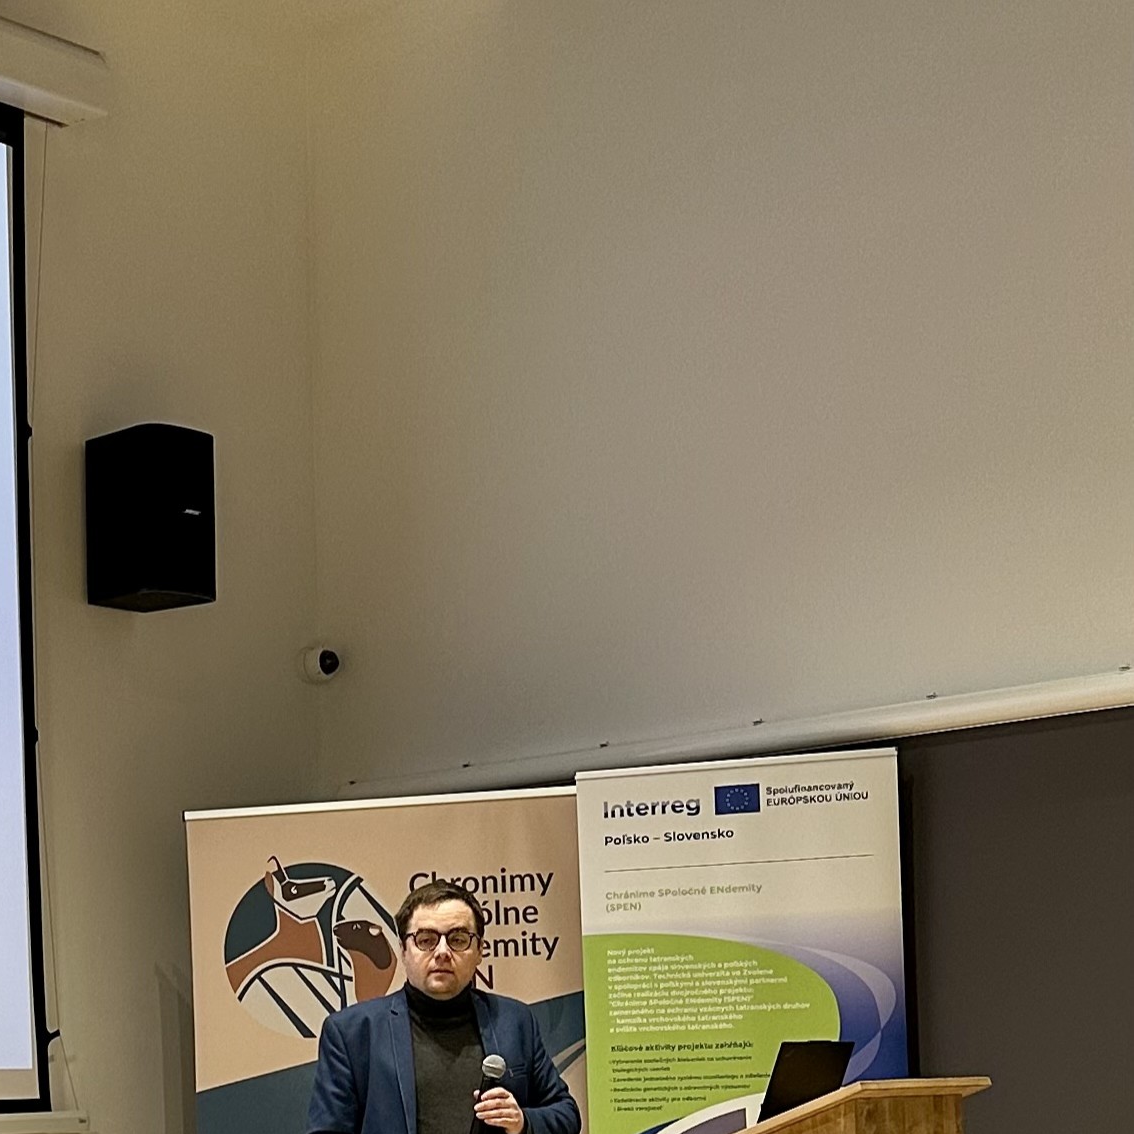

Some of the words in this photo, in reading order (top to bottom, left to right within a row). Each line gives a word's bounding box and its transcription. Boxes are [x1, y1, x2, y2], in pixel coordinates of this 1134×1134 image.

[603, 797, 701, 819] Interreg
[766, 791, 833, 807] EURÓPSKOU
[604, 833, 650, 846] Poľsko
[663, 828, 734, 843] Slovensko
[605, 887, 656, 900] Chránime
[710, 882, 763, 896] ENdemity
[482, 900, 539, 926] ólne
[605, 902, 642, 914] (SPEN)
[482, 931, 560, 961] emity
